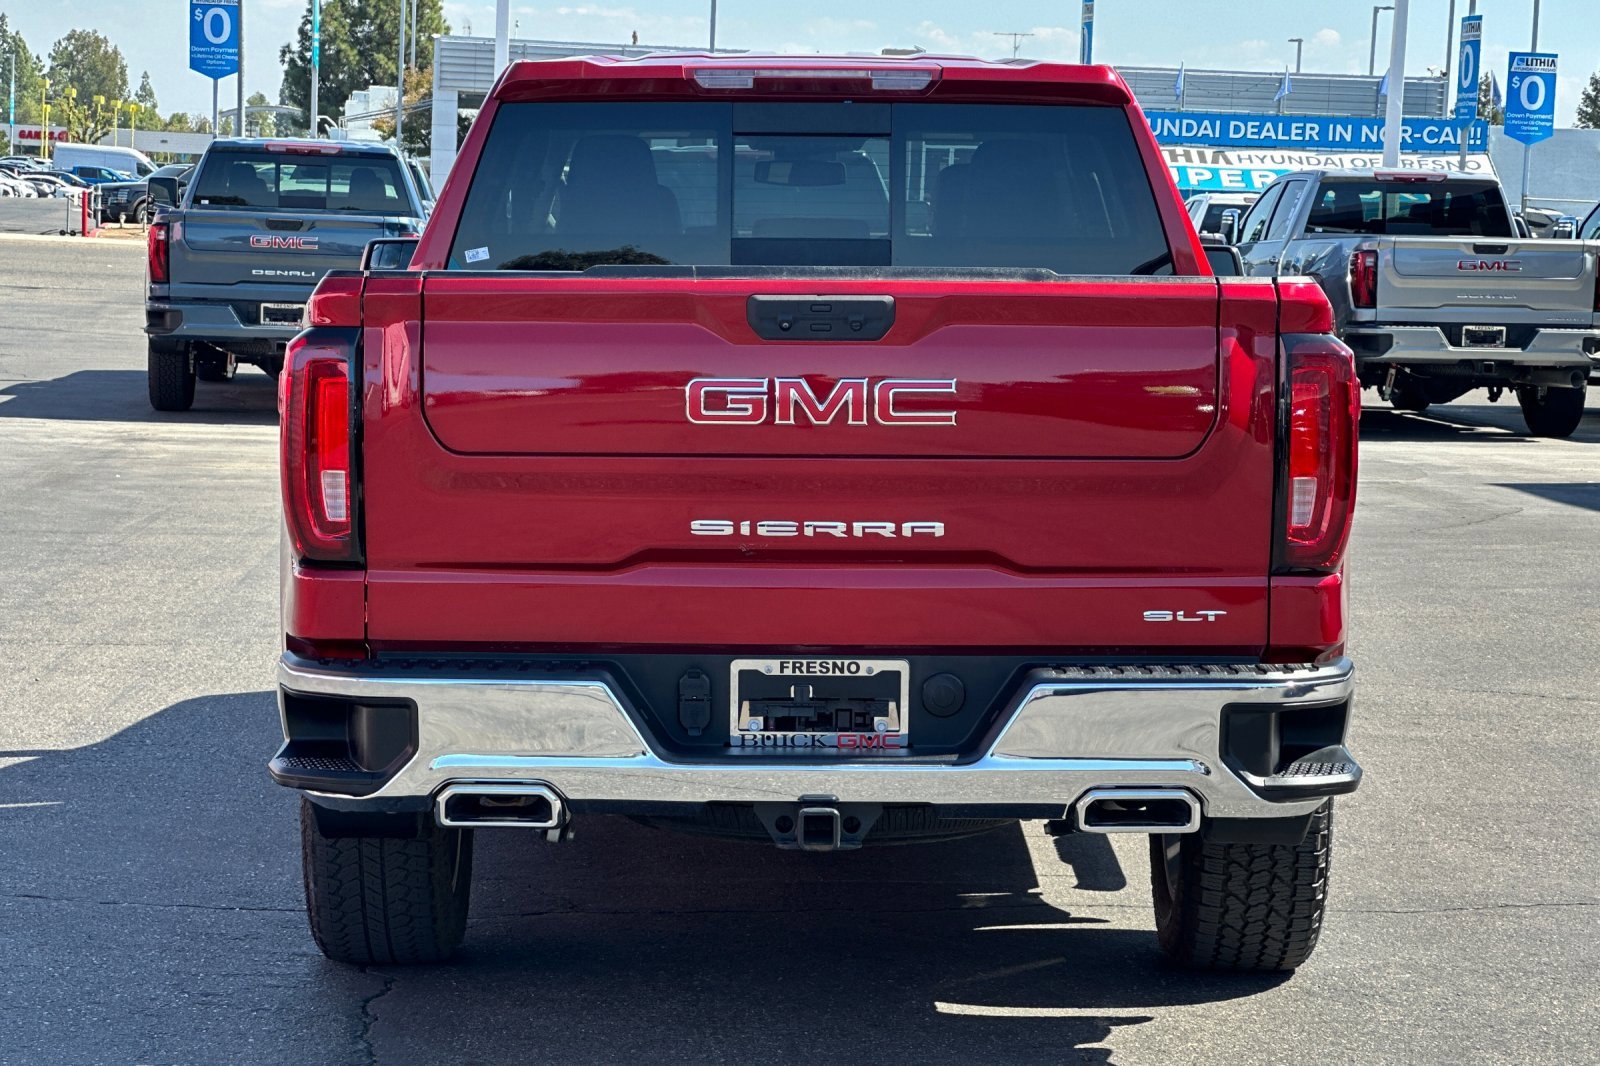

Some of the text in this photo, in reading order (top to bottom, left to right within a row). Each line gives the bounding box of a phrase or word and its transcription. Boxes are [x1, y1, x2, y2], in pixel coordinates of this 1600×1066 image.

[1526, 58, 1556, 67] LITHIA
[1512, 75, 1546, 111] $0
[1146, 118, 1221, 138] UNDAI
[1229, 121, 1319, 141] DEALER
[1328, 123, 1352, 142] IN
[1237, 154, 1344, 168] HYUNDAI
[1350, 157, 1380, 168] OF
[250, 235, 318, 249] GMC
[1457, 260, 1522, 271] GMC
[685, 378, 957, 425] GMC
[690, 520, 945, 538] SIERRA
[1143, 610, 1227, 621] SLT
[779, 661, 861, 675] FRESNO
[739, 734, 901, 749] BUICK GMC
